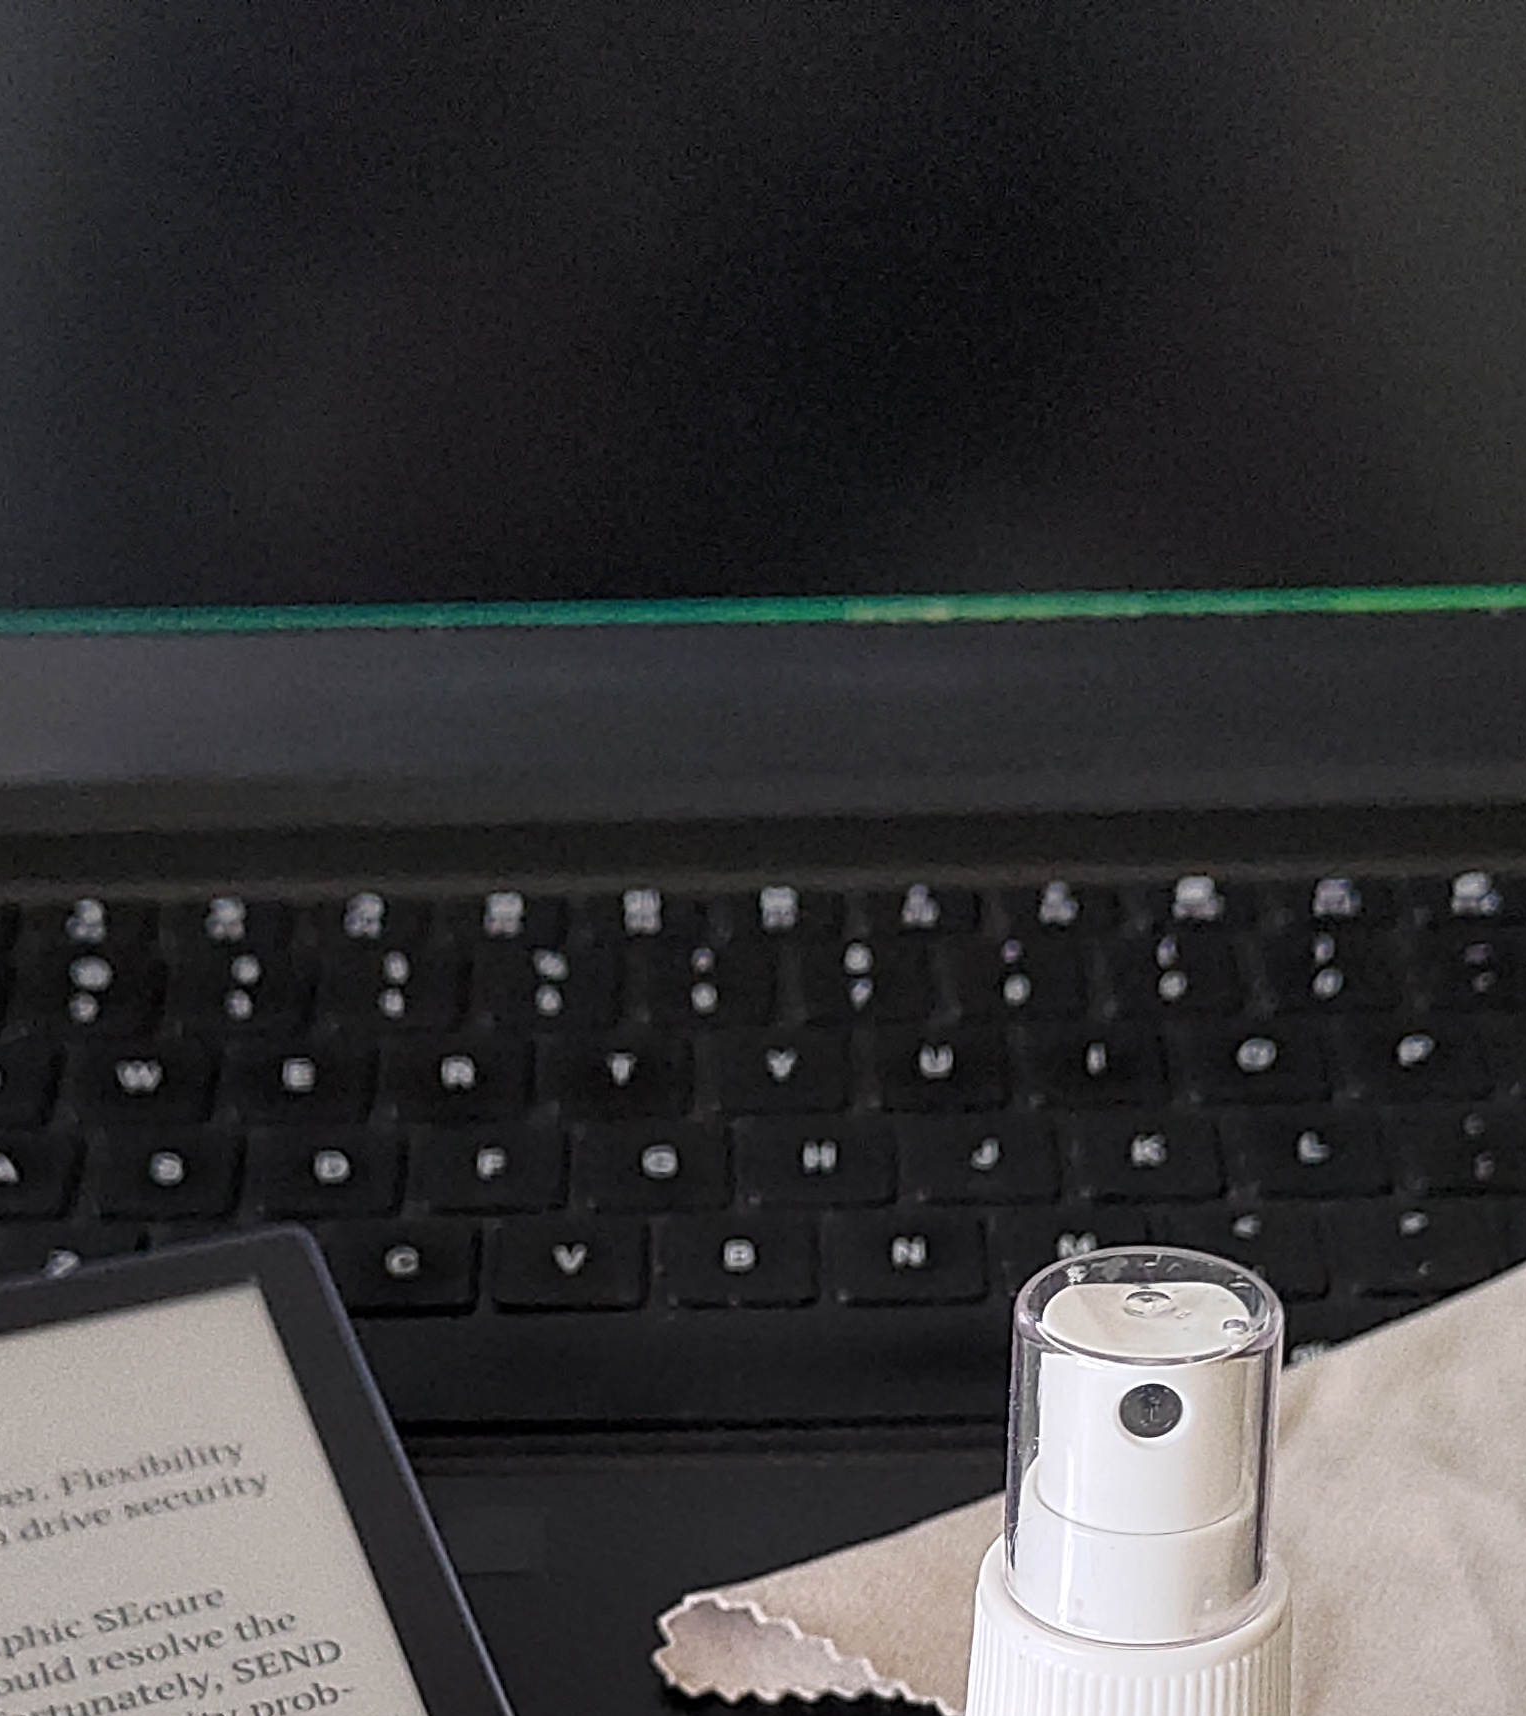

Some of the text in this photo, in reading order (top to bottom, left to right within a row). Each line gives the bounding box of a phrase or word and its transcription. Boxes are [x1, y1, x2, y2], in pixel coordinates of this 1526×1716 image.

[918, 1046, 955, 1078] U
[801, 1142, 838, 1171] H
[971, 1139, 1000, 1170] J
[1297, 1131, 1327, 1164] L
[384, 1245, 420, 1276] C
[553, 1244, 588, 1274] V
[891, 1236, 927, 1267] N
[230, 1639, 342, 1685] SEND
